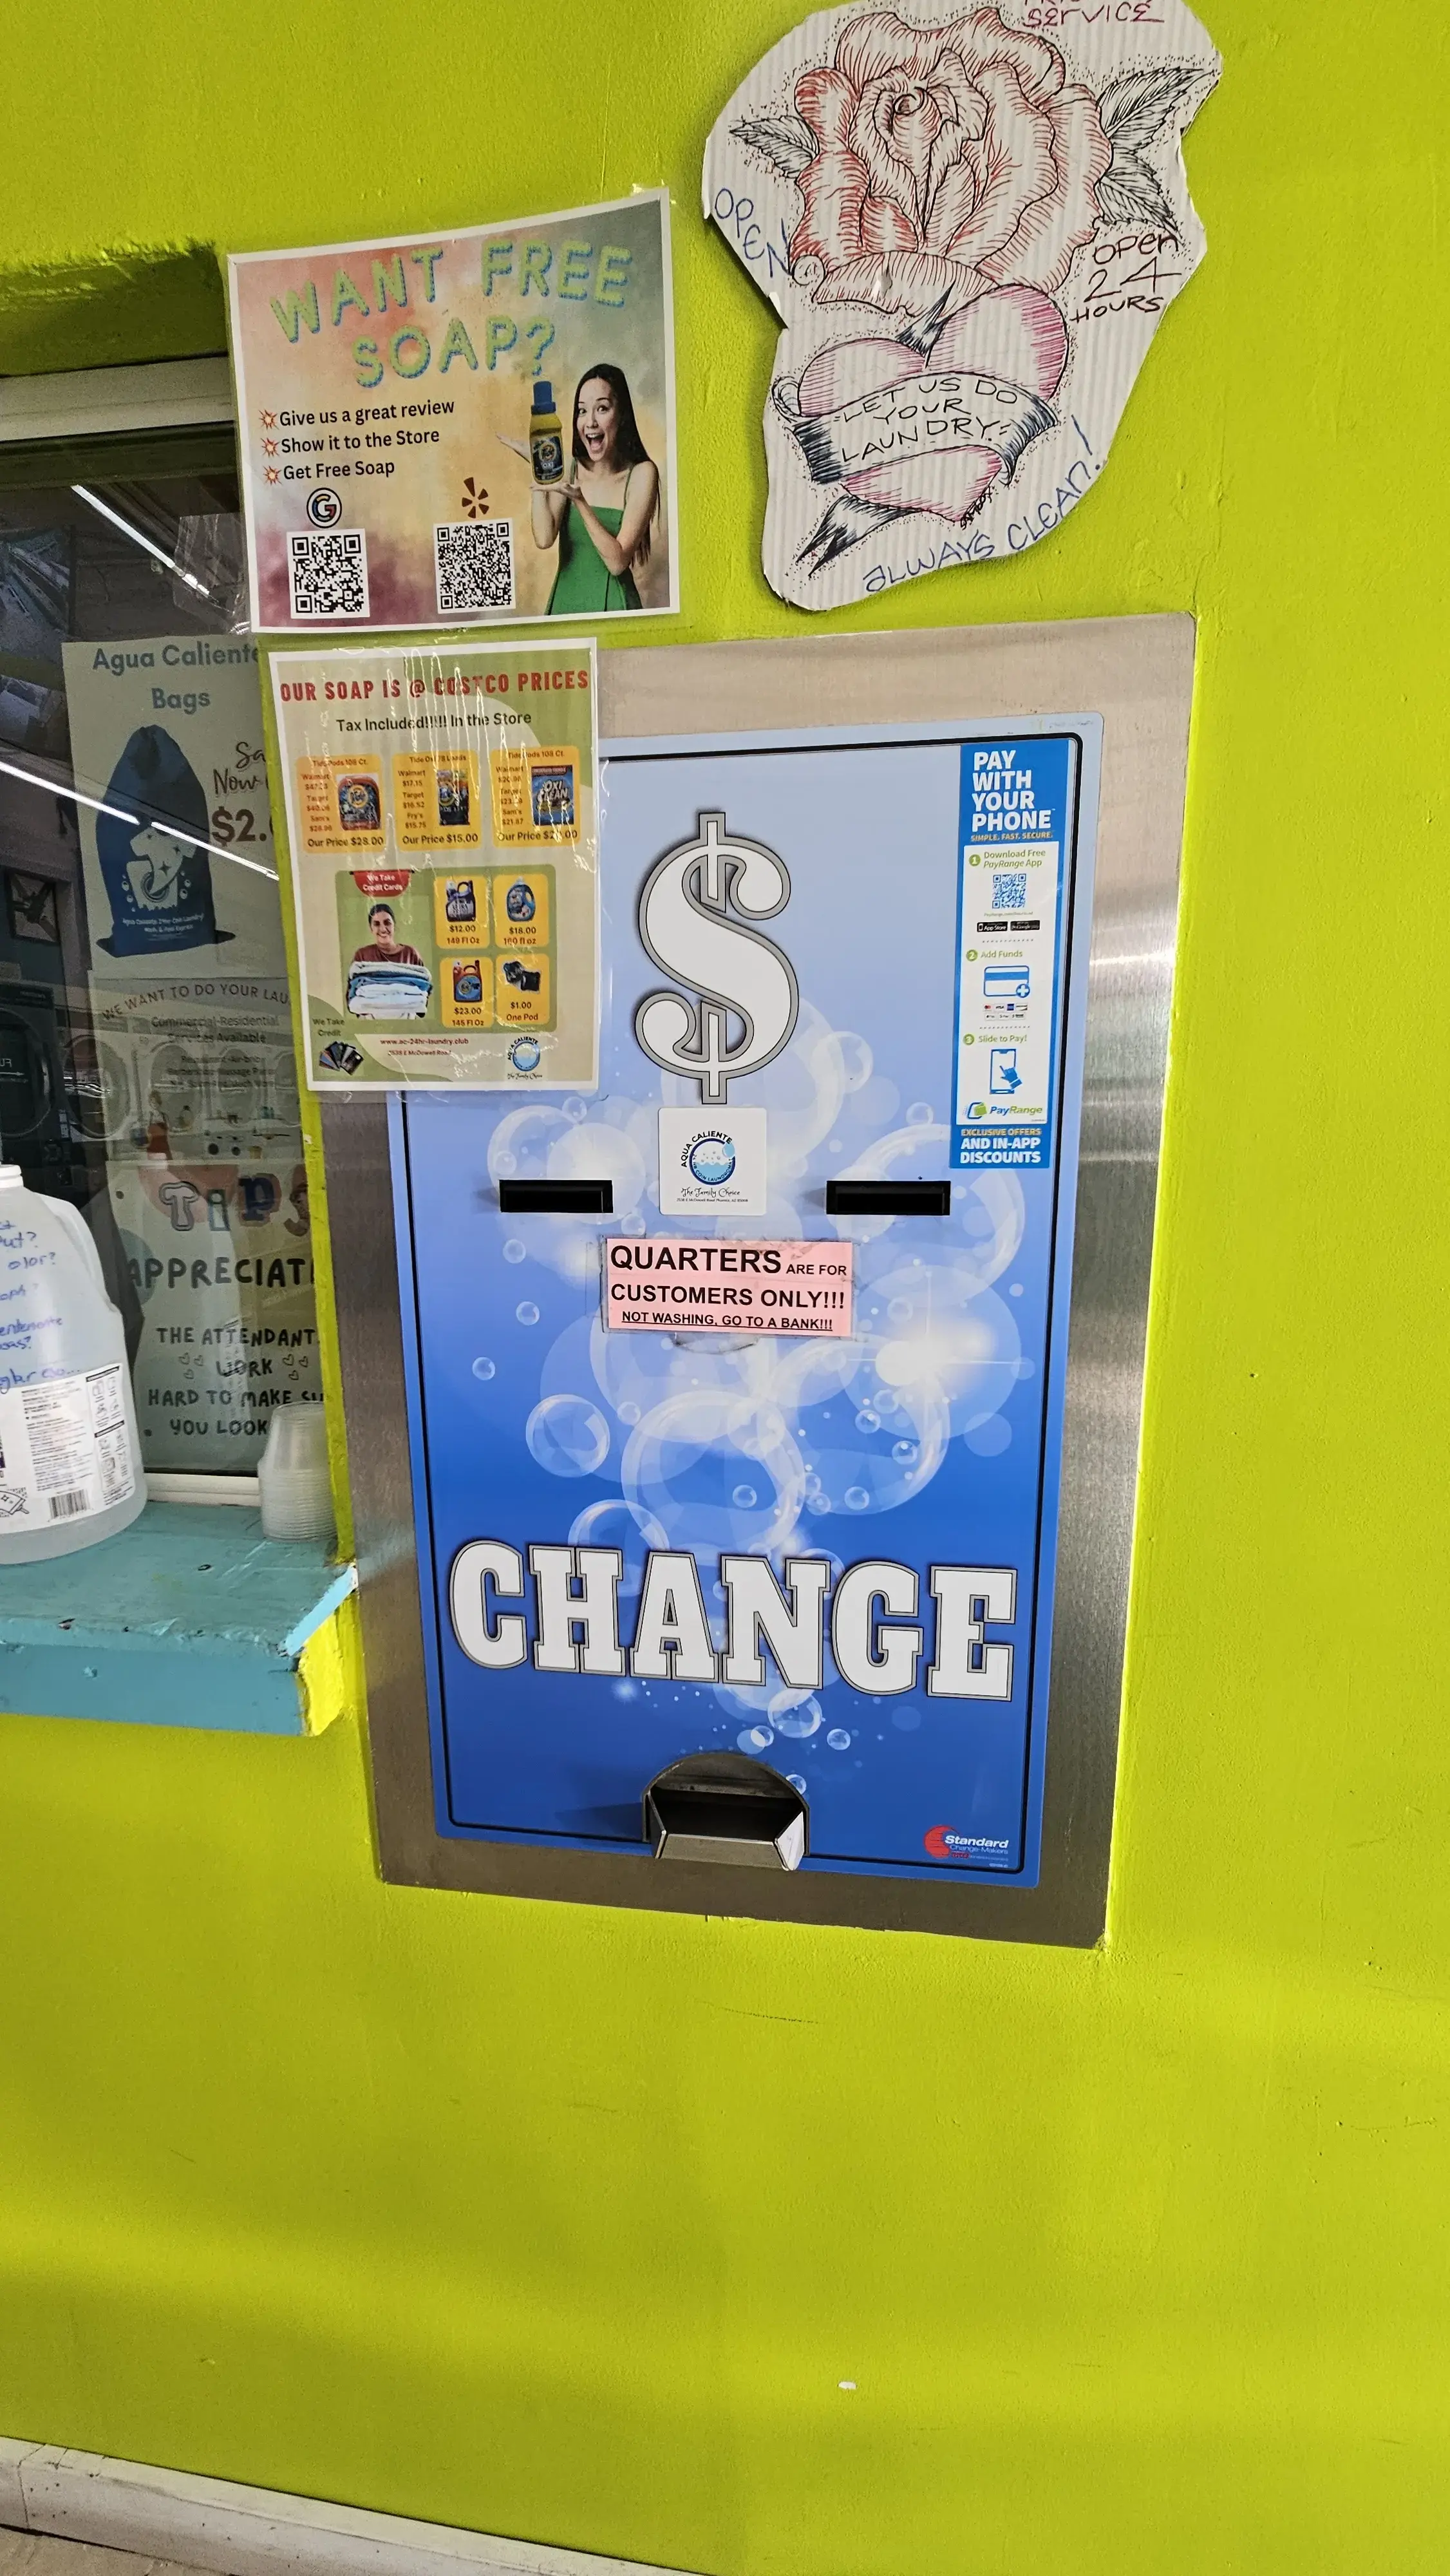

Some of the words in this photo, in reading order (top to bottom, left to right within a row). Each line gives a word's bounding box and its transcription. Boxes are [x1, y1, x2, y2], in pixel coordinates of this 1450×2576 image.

[713, 188, 794, 278] OPEN
[270, 247, 444, 344] WANT
[480, 240, 634, 308] FREE
[1086, 264, 1181, 303] 24
[1069, 294, 1164, 323] HOURS
[351, 315, 556, 388] SOAP?
[843, 389, 908, 422] LET
[918, 378, 962, 395] US
[975, 381, 1018, 404] DO
[279, 411, 315, 428] Give
[319, 409, 338, 424] us
[341, 410, 351, 422] a
[355, 404, 397, 424] great
[400, 400, 455, 417] review
[873, 397, 972, 425] YOUR
[281, 436, 325, 453] Show
[328, 435, 339, 450] it
[343, 435, 361, 450] to
[364, 431, 392, 447] the
[395, 429, 440, 446] Store
[283, 464, 310, 480] Get
[315, 462, 350, 478] Free
[354, 460, 395, 478] Soap
[92, 648, 155, 676] Agua
[280, 681, 317, 703] OUR
[325, 680, 374, 699] SOAP
[382, 679, 400, 698] IS
[410, 679, 425, 698] @
[434, 673, 509, 696] COSTCO
[518, 670, 588, 691] PRICES
[151, 688, 211, 714] Bags
[336, 718, 362, 732] Tax
[451, 713, 463, 727] In
[466, 712, 489, 726] the
[493, 712, 531, 725] Store
[974, 750, 1016, 771] PAY
[213, 768, 259, 797] Now
[972, 770, 1031, 791] WITH
[972, 791, 1035, 811] YOUR
[972, 810, 1051, 832] PHONE
[308, 838, 323, 847] Our
[326, 838, 348, 846] Price
[422, 835, 444, 844] Price
[446, 833, 478, 844] $15.00
[498, 833, 514, 841] Our
[518, 831, 541, 840] Price
[983, 860, 1024, 869] PayRange
[1026, 858, 1042, 867] App
[984, 851, 1026, 859] Download
[378, 873, 395, 882] Take
[449, 925, 476, 933] $12.00
[634, 812, 799, 1104] $
[102, 1004, 122, 1020] WE
[124, 989, 165, 1010] WANT
[170, 985, 189, 998] TO
[195, 983, 214, 995] DO
[220, 984, 258, 997] YOUR
[325, 1018, 344, 1026] Take
[216, 1032, 266, 1043] Available
[514, 1036, 538, 1045] CALIENTE
[1010, 1035, 1027, 1043] Pay!
[990, 1105, 1042, 1115] PayRange
[681, 1143, 692, 1167] AQUA
[692, 1131, 732, 1144] CALIENTE
[961, 1137, 991, 1149] AND
[993, 1137, 1040, 1148] IN-APP
[961, 1151, 1041, 1163] DISCOUNTS
[696, 1170, 706, 1180] COIN
[708, 1159, 732, 1181] LAUNDROMAT
[681, 1187, 693, 1197] The
[694, 1188, 716, 1197] Family
[719, 1188, 740, 1197] Choice
[611, 1245, 780, 1273] QUARTERS
[786, 1264, 814, 1274] ARE
[820, 1265, 847, 1276] FOR
[129, 1258, 314, 1287] APPRECIAT
[611, 1283, 752, 1305] CUSTOMERS
[760, 1290, 844, 1309] ONLY!!!
[622, 1311, 649, 1322] NOT
[652, 1312, 717, 1326] WASHING,
[722, 1316, 741, 1326] GO
[748, 1317, 763, 1327] TO
[768, 1318, 777, 1327] A
[781, 1318, 832, 1329] BANK!!!
[156, 1327, 194, 1343] THE
[201, 1328, 320, 1347] ATTENDANT
[147, 1388, 198, 1406] HARD
[206, 1390, 231, 1405] TO
[241, 1388, 292, 1407] MAKE
[170, 1419, 209, 1435] YOU
[216, 1419, 267, 1435] LOOK
[449, 1540, 1017, 1702] CHANGE
[945, 1835, 1009, 1848] Standard
